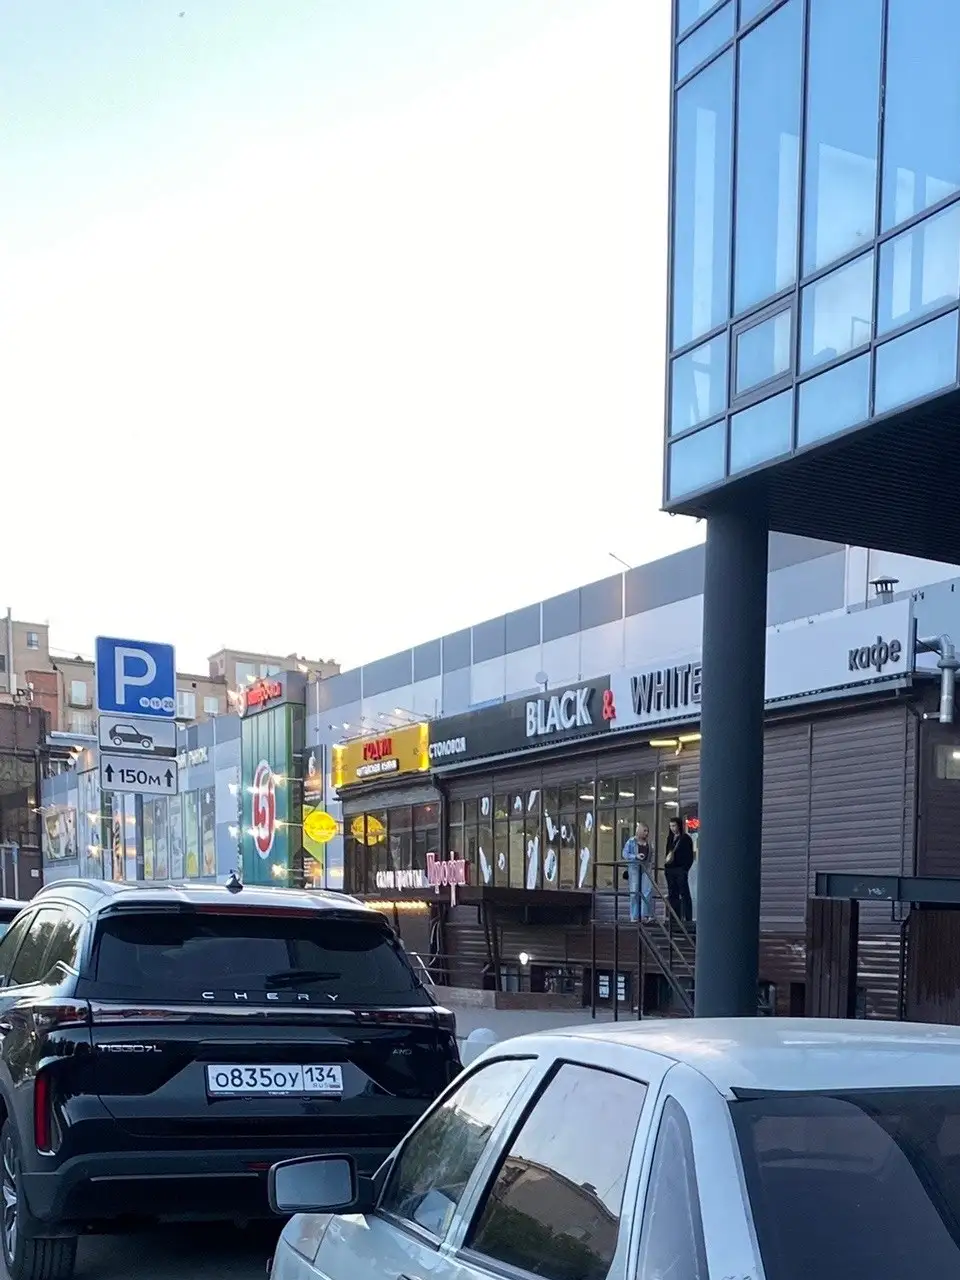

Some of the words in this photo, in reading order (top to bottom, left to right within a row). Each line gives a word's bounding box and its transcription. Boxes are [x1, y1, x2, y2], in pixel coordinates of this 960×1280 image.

[848, 635, 902, 673] кафе
[114, 646, 157, 705] P
[163, 700, 174, 709] 20
[526, 686, 593, 738] BLACK
[602, 689, 617, 720] &
[630, 660, 702, 716] WHITE
[201, 991, 339, 1001] CHERY
[304, 1066, 337, 1083] 134
